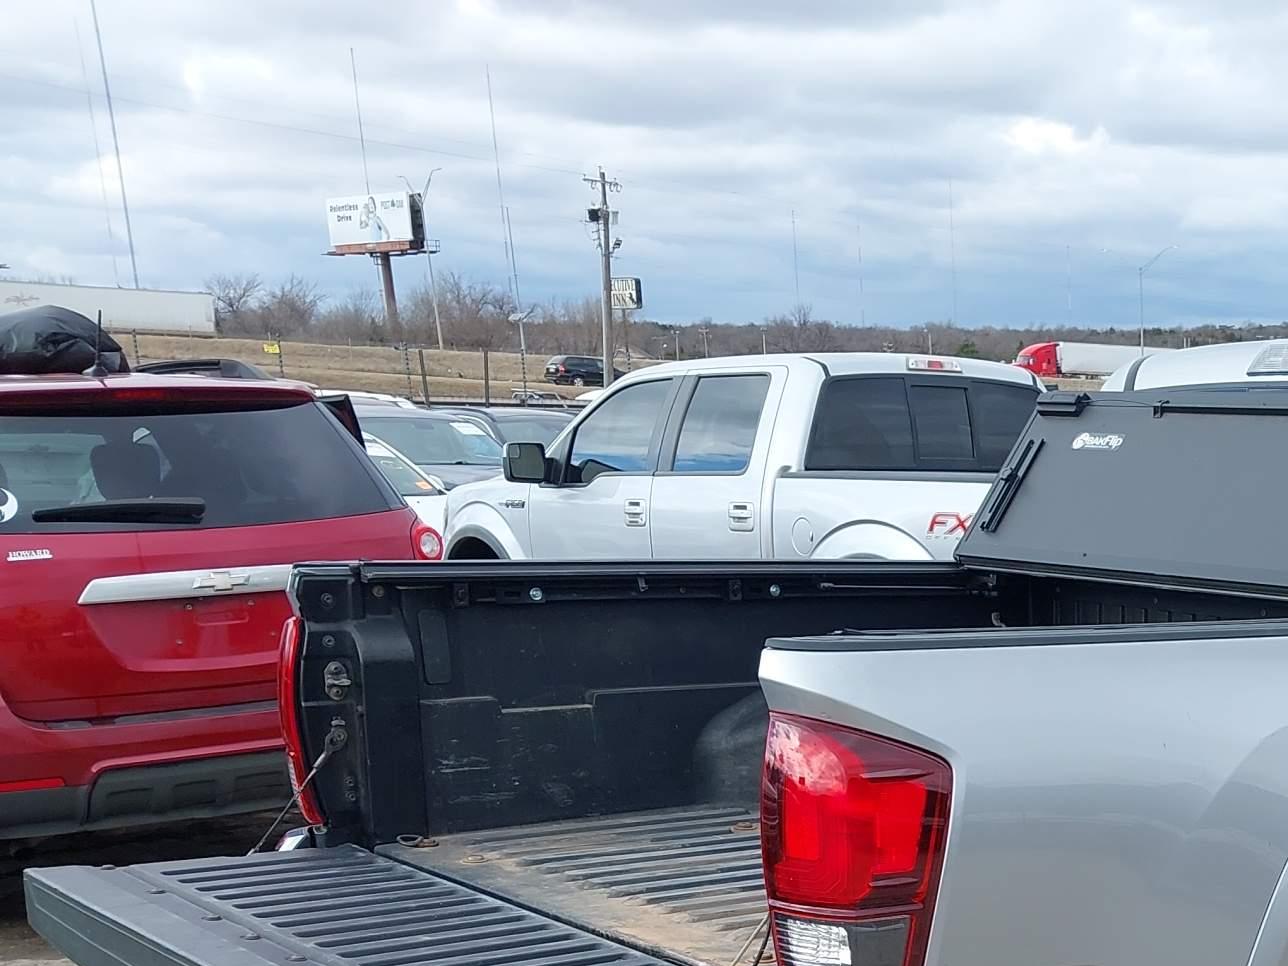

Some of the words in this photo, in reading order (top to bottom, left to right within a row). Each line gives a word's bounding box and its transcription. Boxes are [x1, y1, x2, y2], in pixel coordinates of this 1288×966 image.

[329, 203, 359, 213] Relentless
[336, 213, 353, 223] Drive
[613, 293, 628, 307] INN
[7, 548, 51, 560] HOWARD
